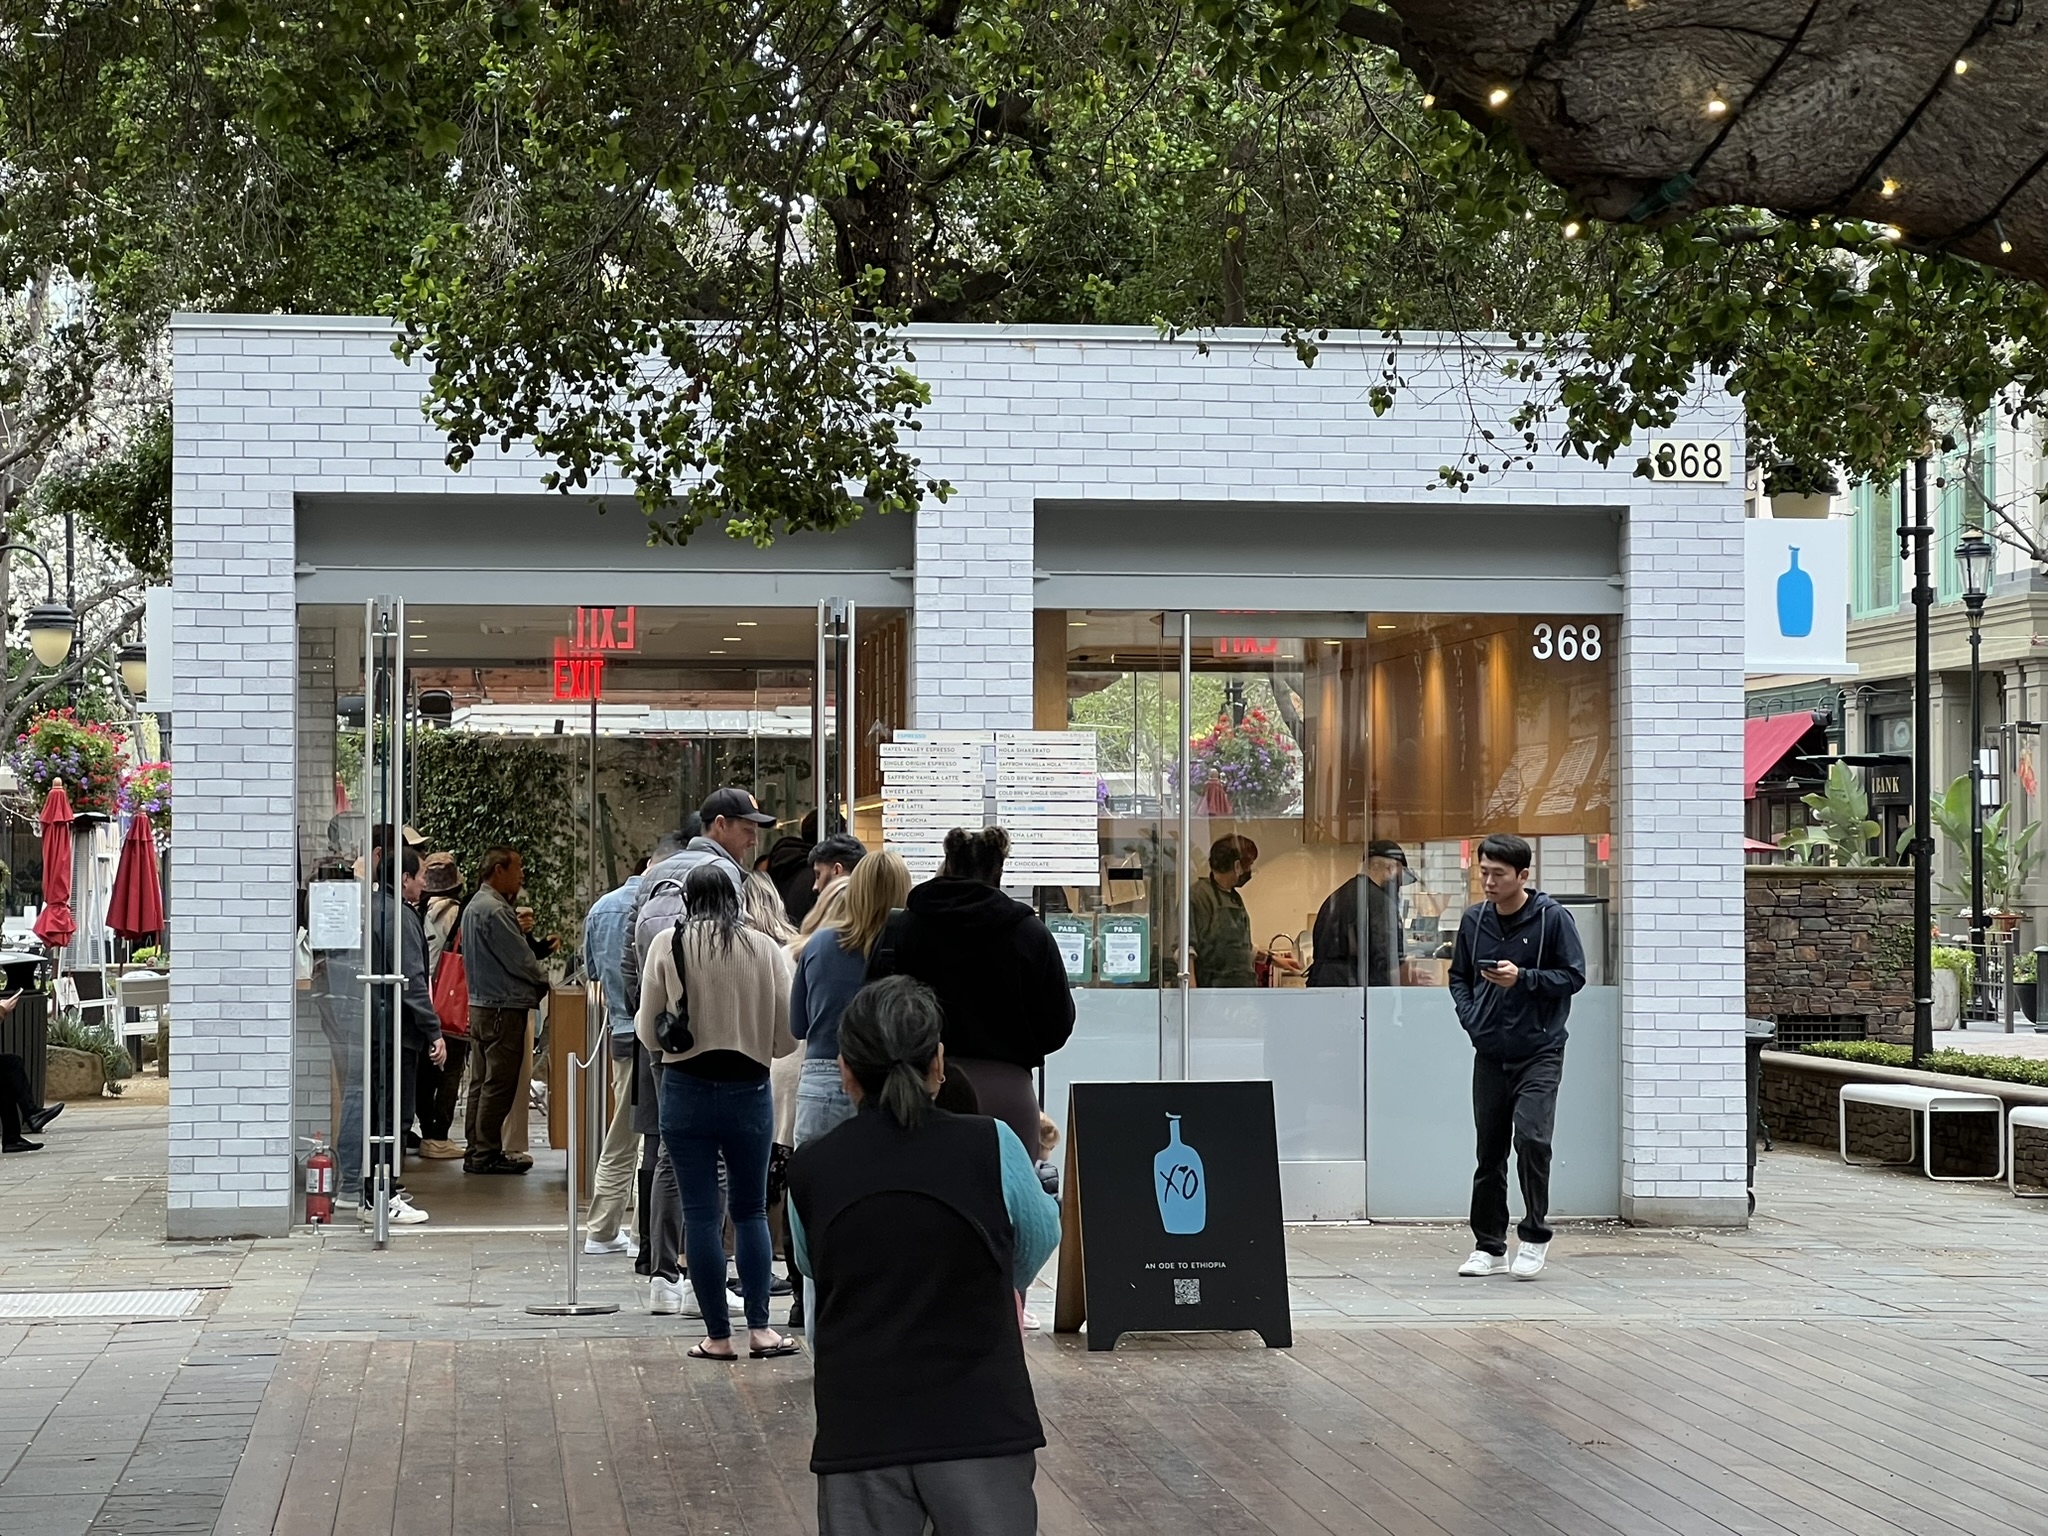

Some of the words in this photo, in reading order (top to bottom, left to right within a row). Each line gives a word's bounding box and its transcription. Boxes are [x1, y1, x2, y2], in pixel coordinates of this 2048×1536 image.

[1658, 442, 1722, 479] 368
[1532, 622, 1602, 662] 368
[554, 660, 604, 698] EXIT
[1876, 777, 1899, 793] BANK
[1160, 1164, 1198, 1204] XO
